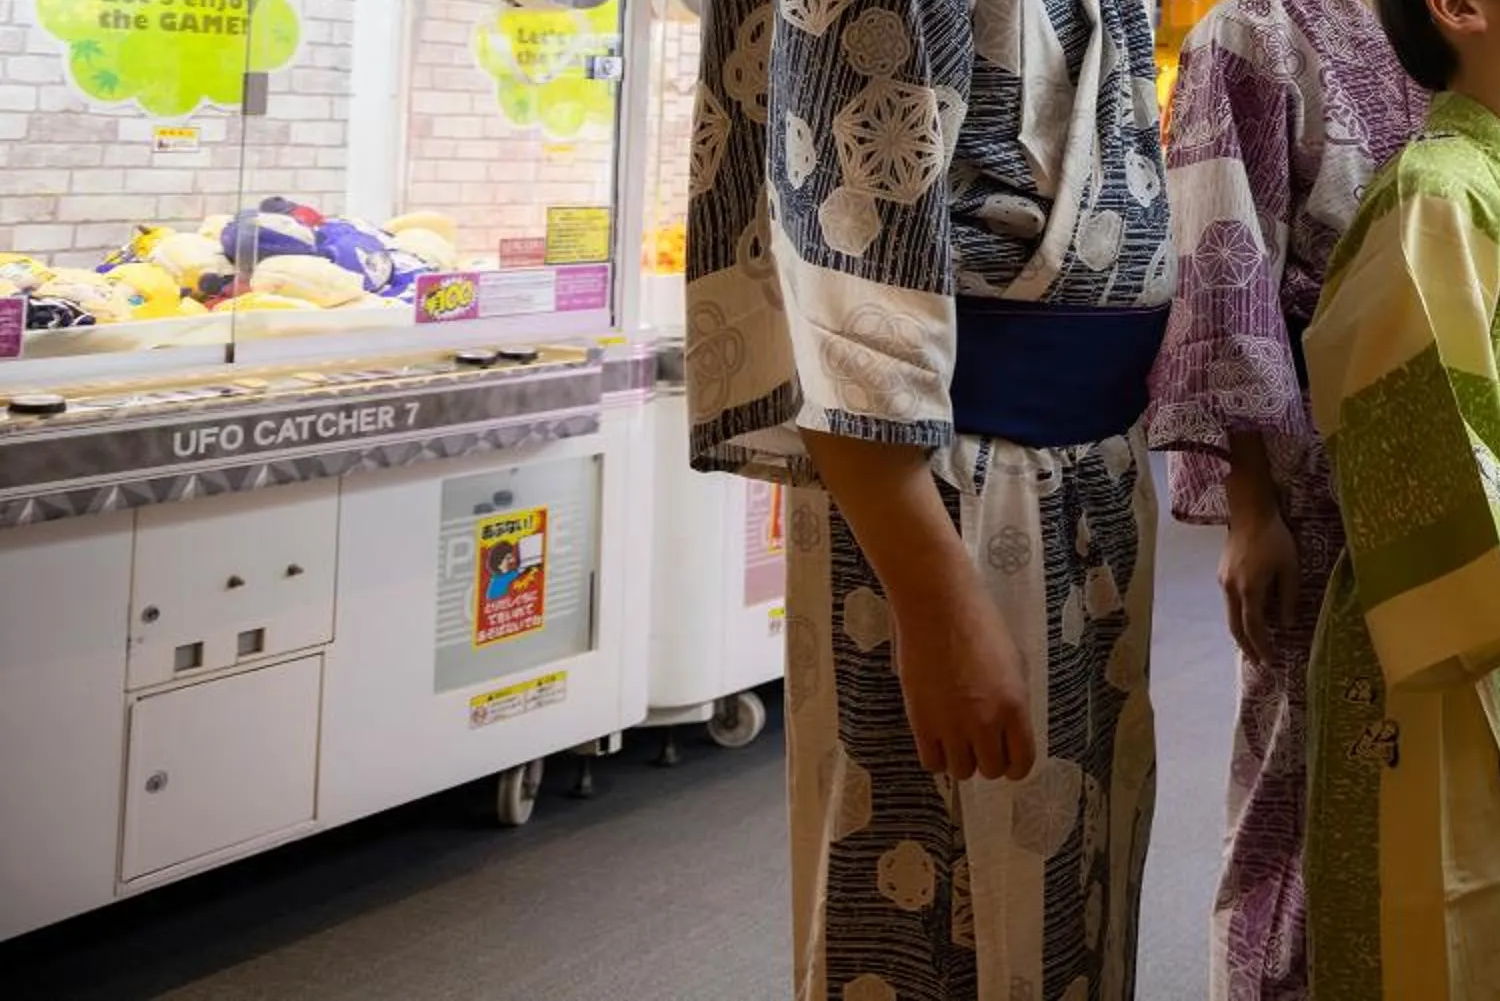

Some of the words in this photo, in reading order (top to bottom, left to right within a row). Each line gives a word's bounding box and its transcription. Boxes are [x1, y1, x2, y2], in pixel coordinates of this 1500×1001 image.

[100, 9, 149, 30] the
[160, 12, 251, 35] GAME!
[173, 424, 245, 456] UFO
[253, 405, 396, 446] CATCHER
[405, 402, 420, 425] 7
